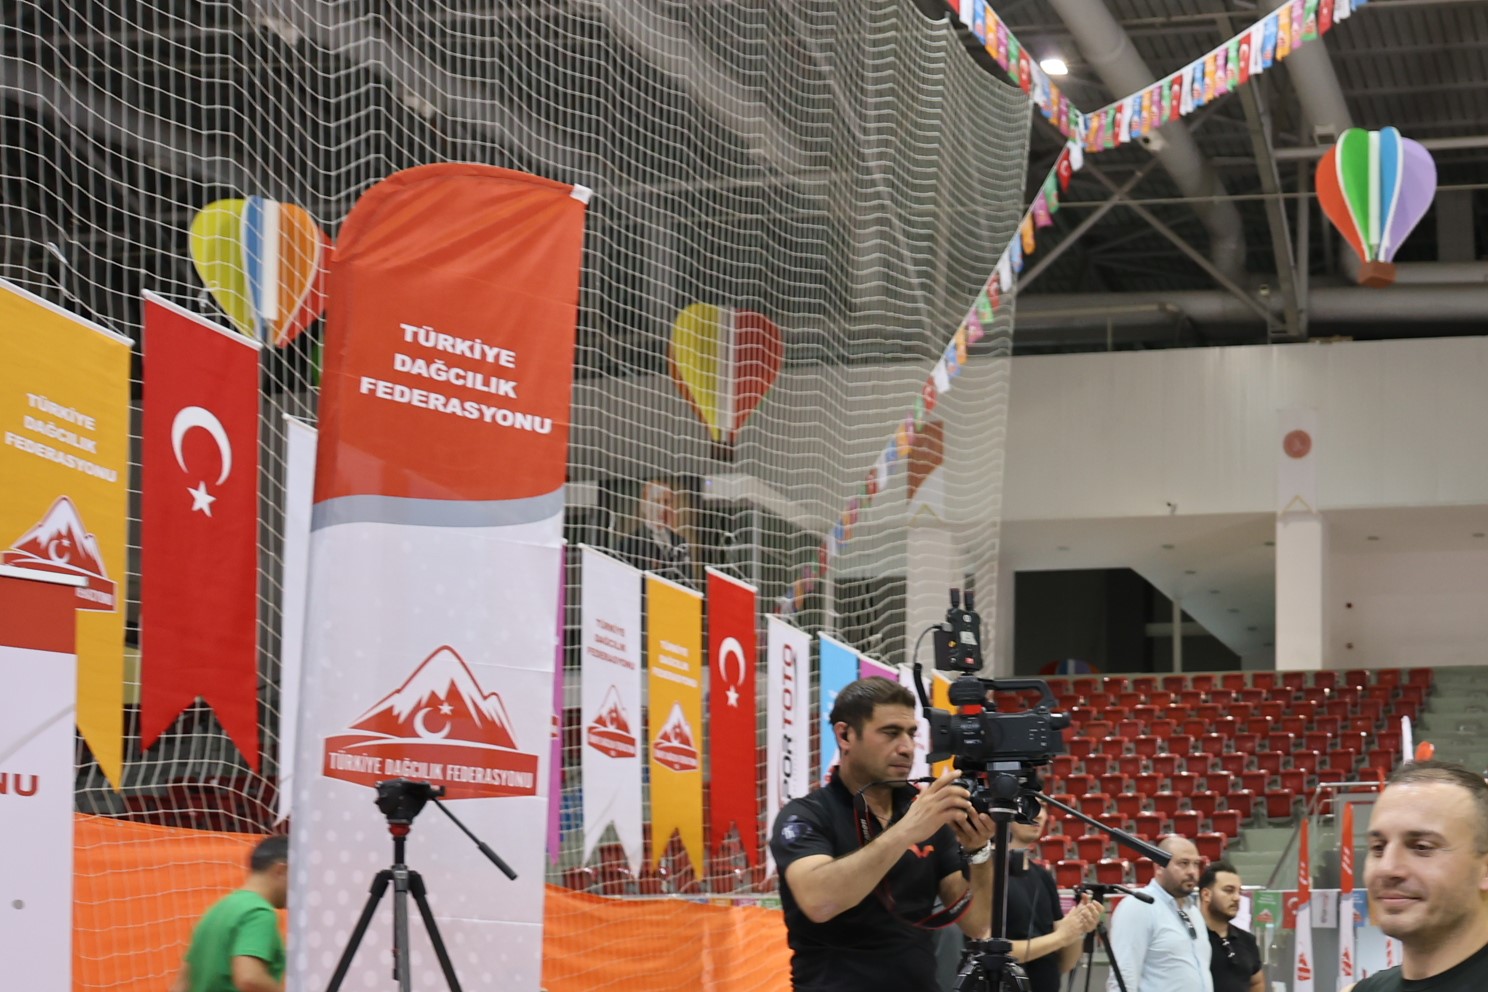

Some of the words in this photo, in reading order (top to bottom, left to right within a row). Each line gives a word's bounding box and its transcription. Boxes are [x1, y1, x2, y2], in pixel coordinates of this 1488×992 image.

[400, 323, 516, 369] TÜRKİYE
[393, 352, 519, 399] DAĞCILIK
[26, 392, 97, 432] TÜRKİYE
[359, 376, 554, 435] FEDERASYONU
[5, 430, 119, 484] FEDERASYONU
[328, 749, 384, 775] TÜRKİYE
[384, 757, 445, 781] DAĞCILIK
[446, 763, 535, 789] FEDERASYONU
